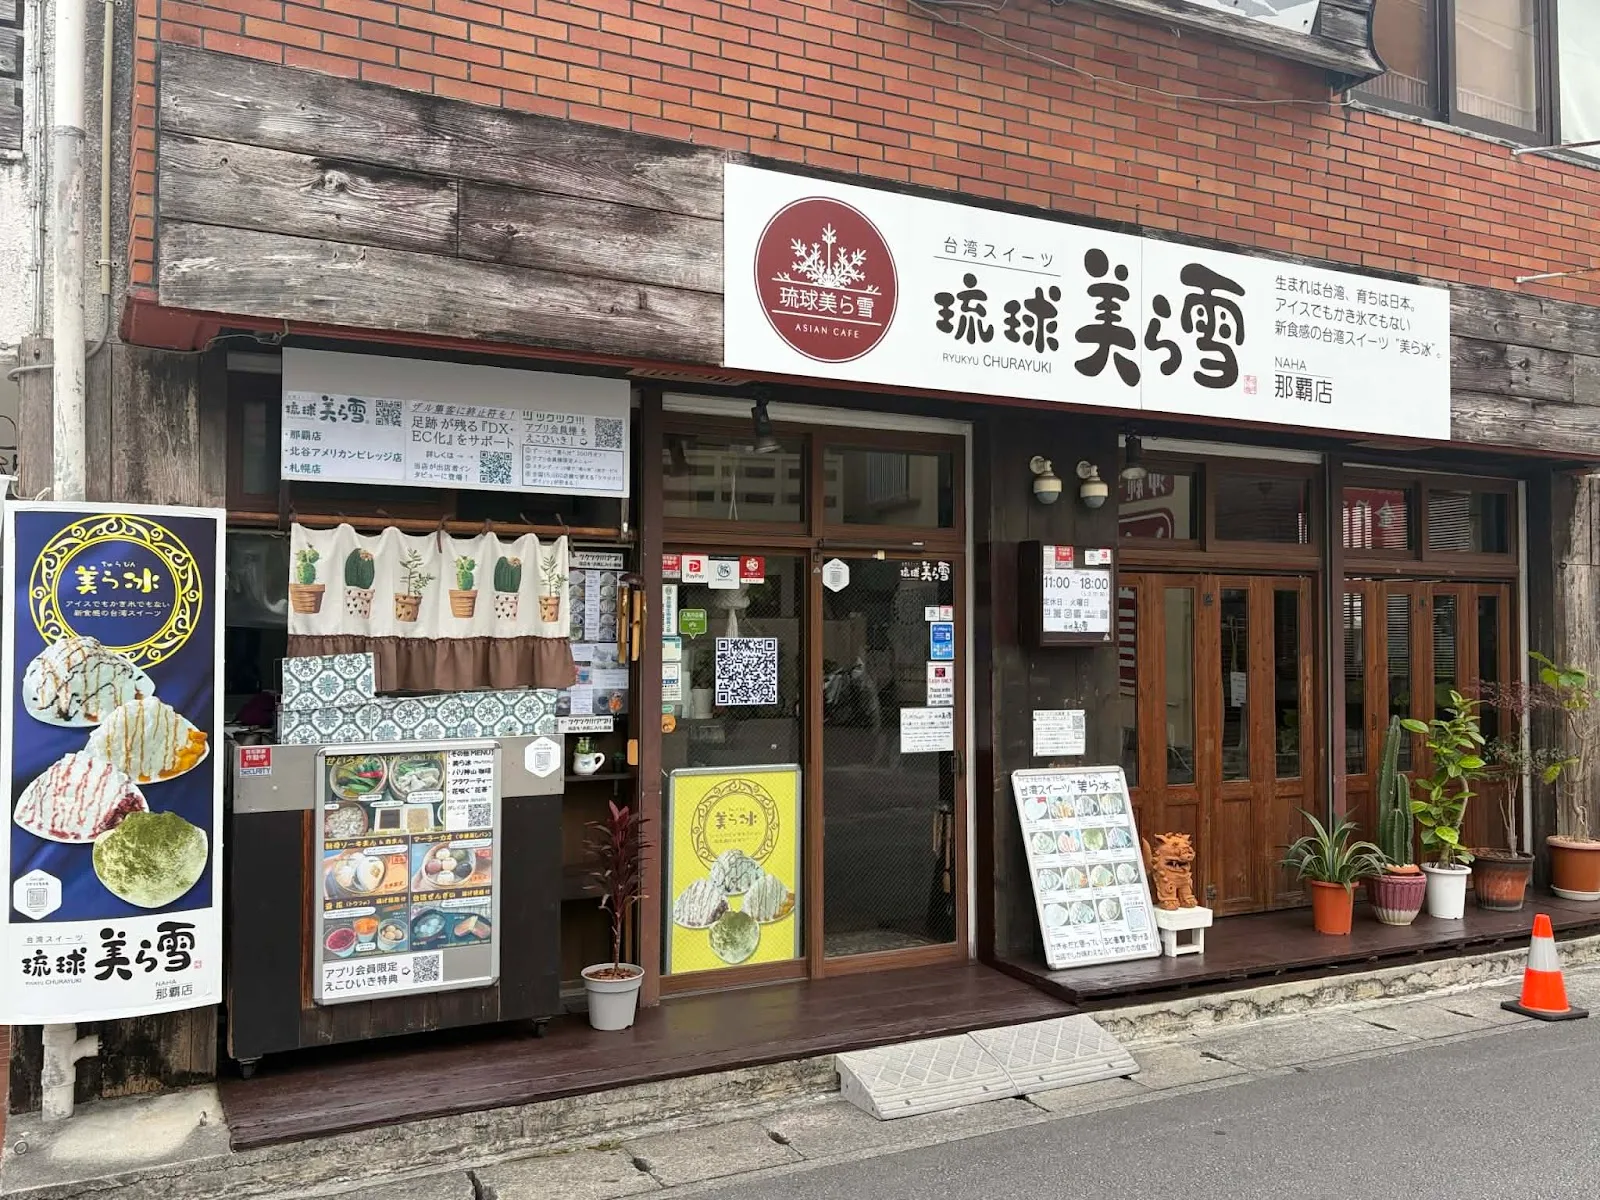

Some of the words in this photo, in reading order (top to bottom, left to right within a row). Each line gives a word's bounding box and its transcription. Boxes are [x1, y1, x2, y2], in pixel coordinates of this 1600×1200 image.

[943, 236, 1054, 268] 台湾スイーツ
[779, 286, 875, 318] 琉球美ら雪
[1275, 298, 1411, 331] アイスでもかき氷でもない
[795, 323, 828, 335] ASIAN
[833, 327, 860, 339] CAFE
[943, 353, 979, 366] RYUKYU
[983, 354, 1052, 374] CHURAYUKI
[1275, 355, 1307, 371] NAHA
[1275, 374, 1333, 404] 那覇店
[285, 395, 367, 423] 琉球美ら雪
[1043, 576, 1070, 588] 11:00
[1079, 577, 1109, 590] 18:00
[26, 934, 84, 944] 台湾スイーツ
[22, 921, 196, 981] 琉球美ら雪
[325, 961, 398, 980] アプリ会員限定
[155, 979, 177, 987] NAHA
[155, 984, 193, 1001] 那覇店
[324, 974, 399, 992] えこひいき特典
